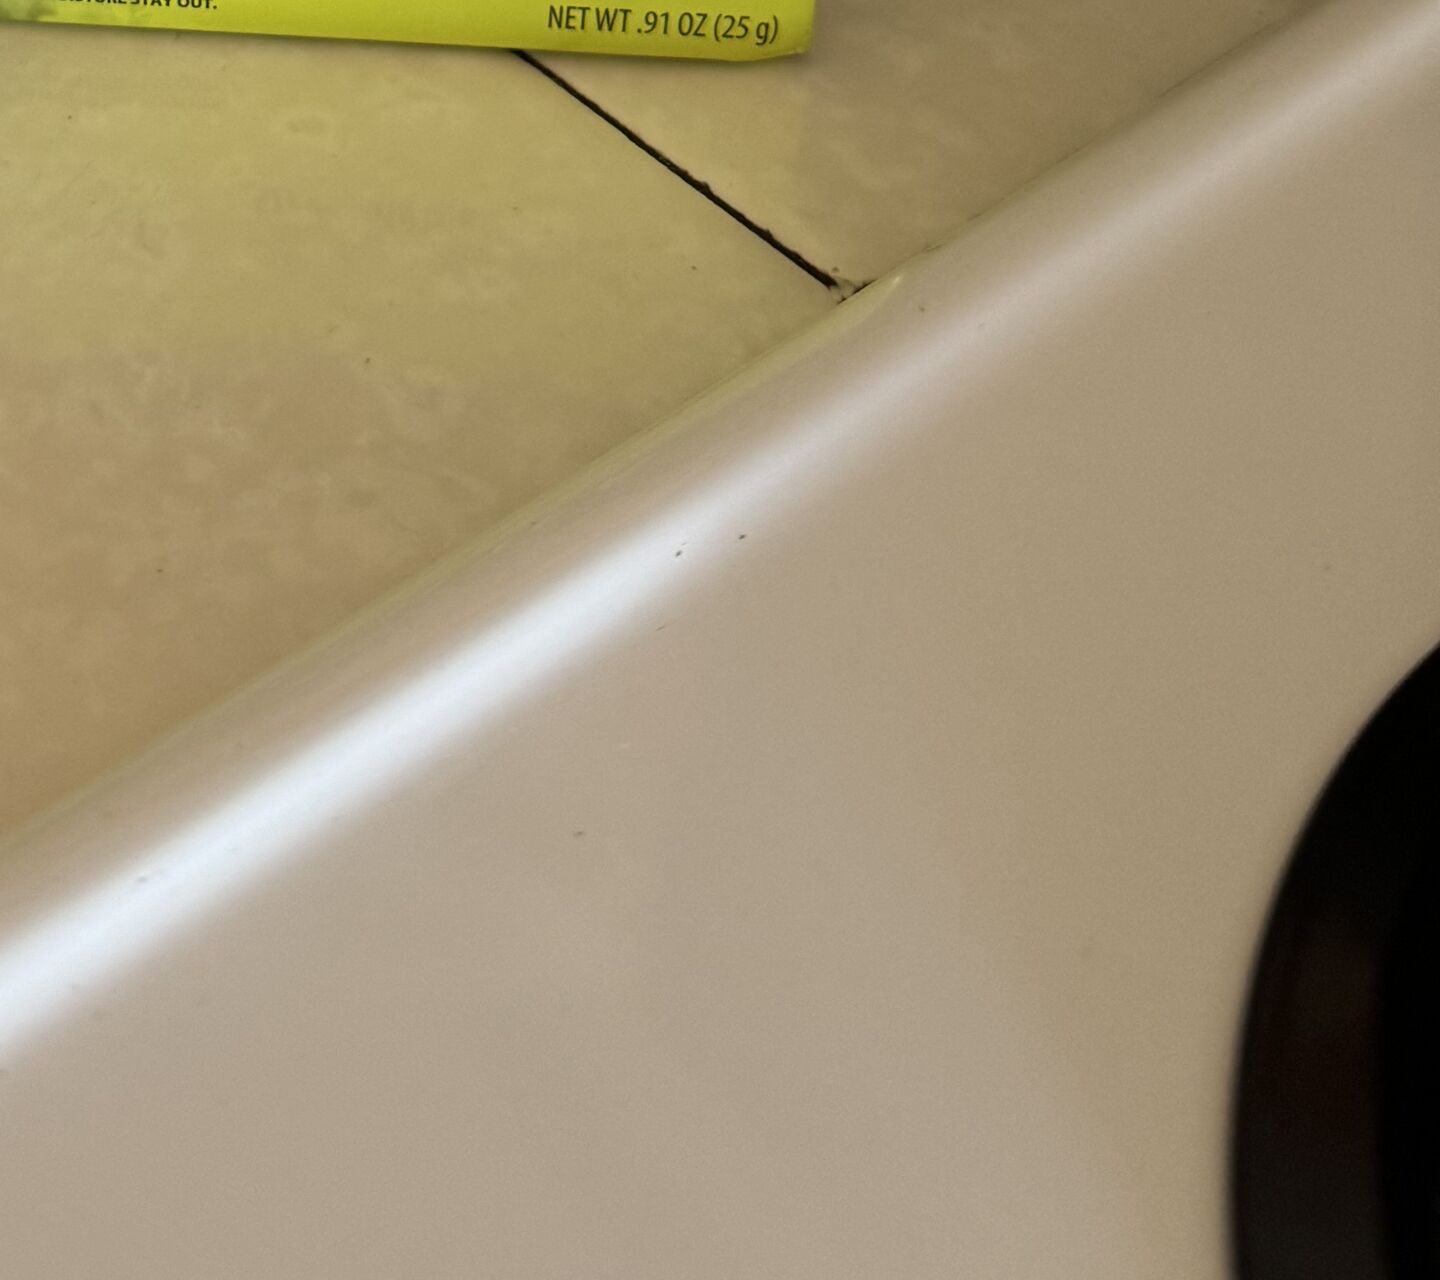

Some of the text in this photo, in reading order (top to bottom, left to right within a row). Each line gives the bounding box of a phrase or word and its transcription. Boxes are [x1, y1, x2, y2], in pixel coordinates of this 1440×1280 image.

[547, 4, 779, 47] NET WT .91 OZ (25 g)
